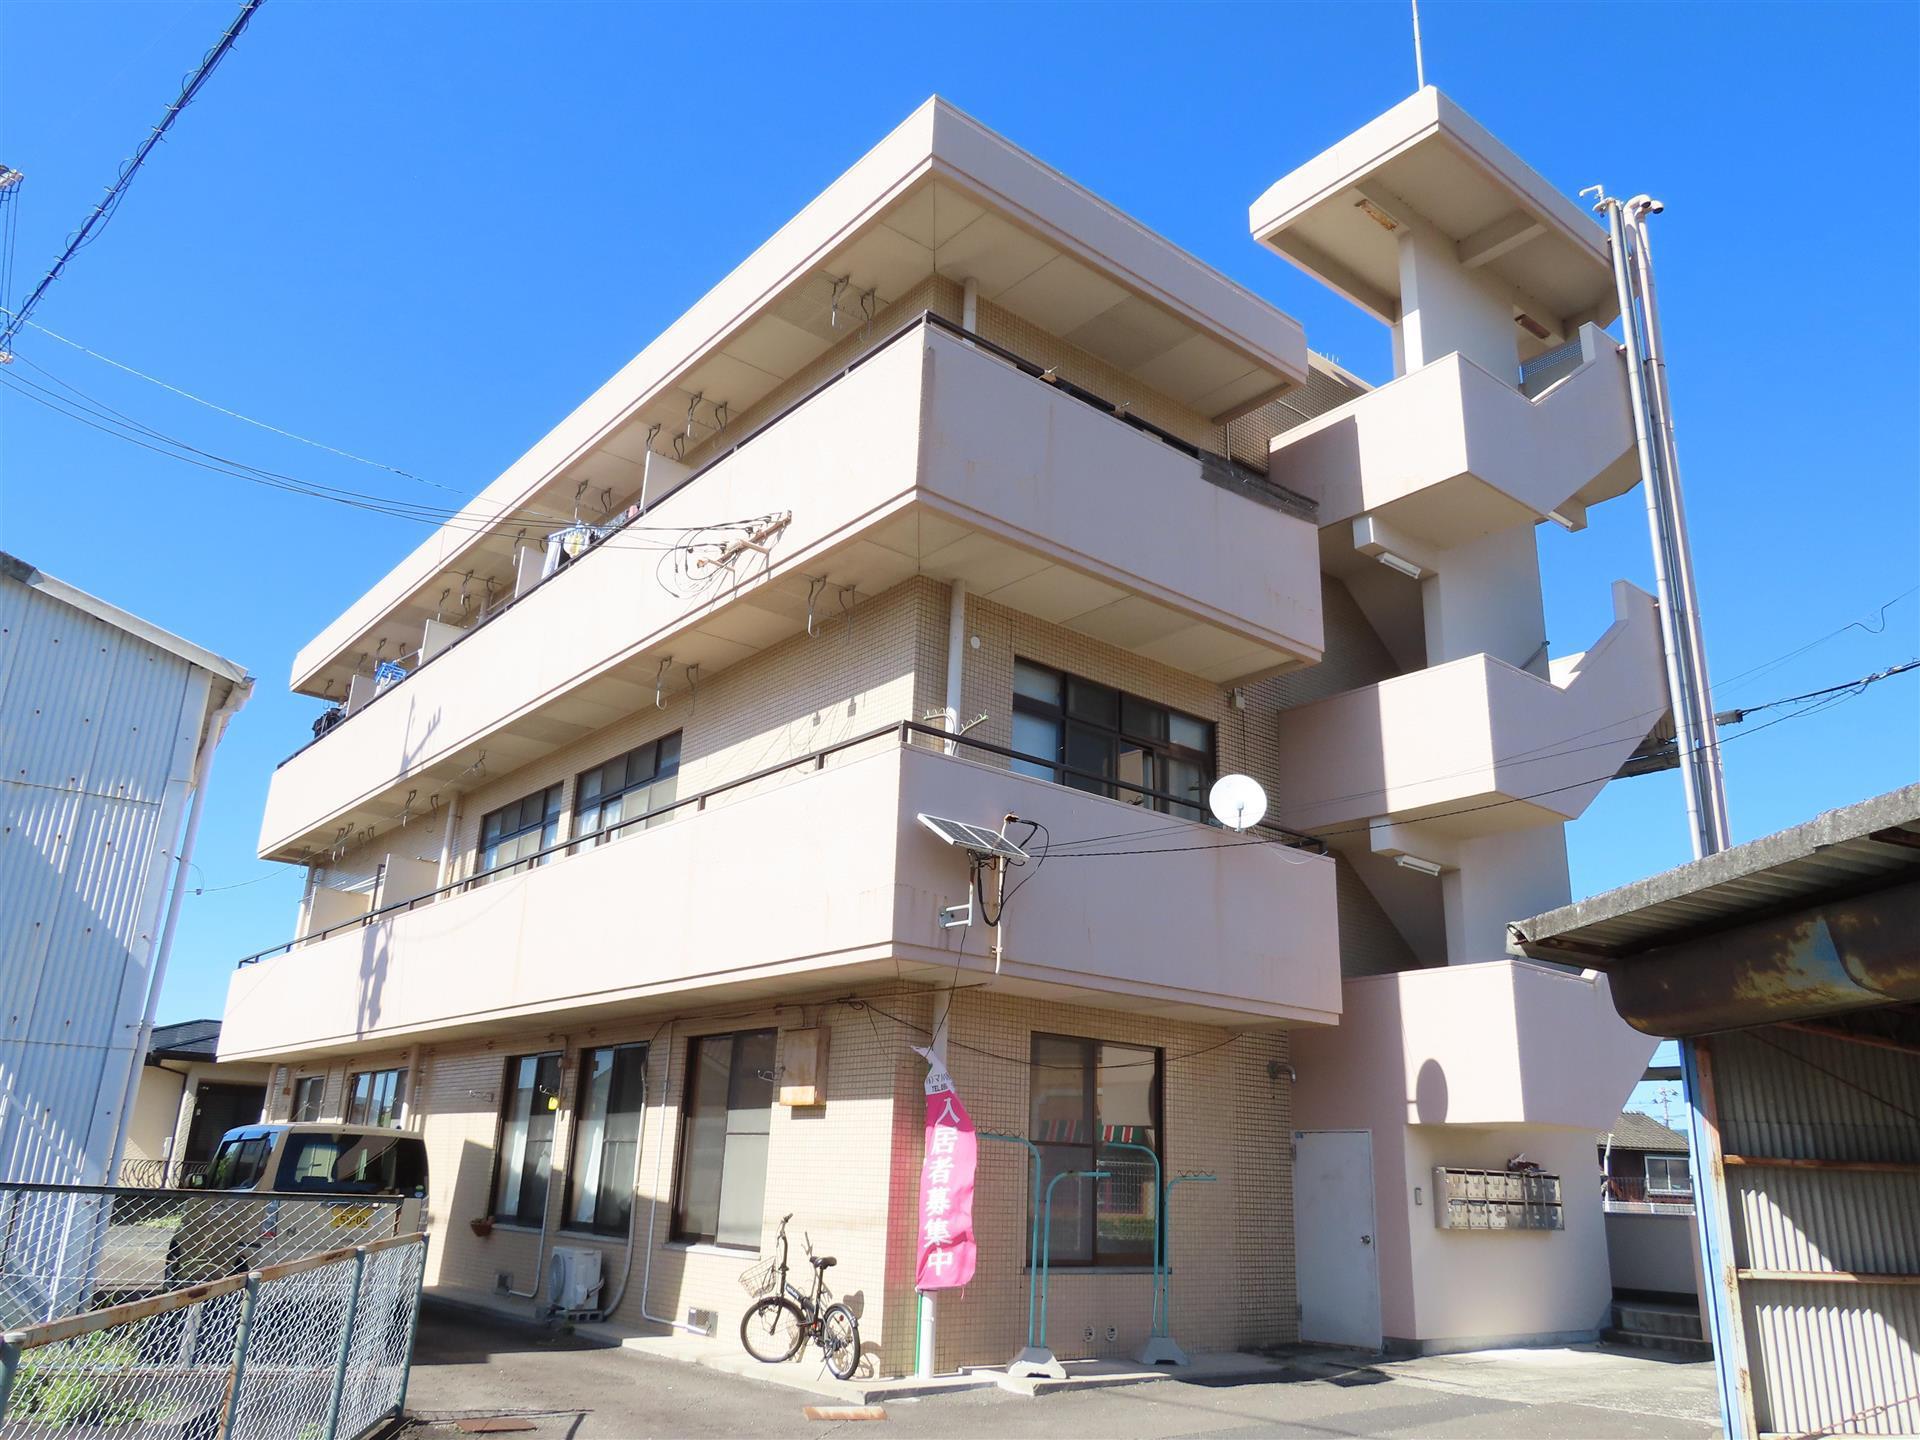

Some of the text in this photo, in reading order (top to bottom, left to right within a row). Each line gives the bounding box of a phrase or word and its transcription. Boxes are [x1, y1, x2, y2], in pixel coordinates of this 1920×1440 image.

[924, 1098, 960, 1275] 入居者募集中
